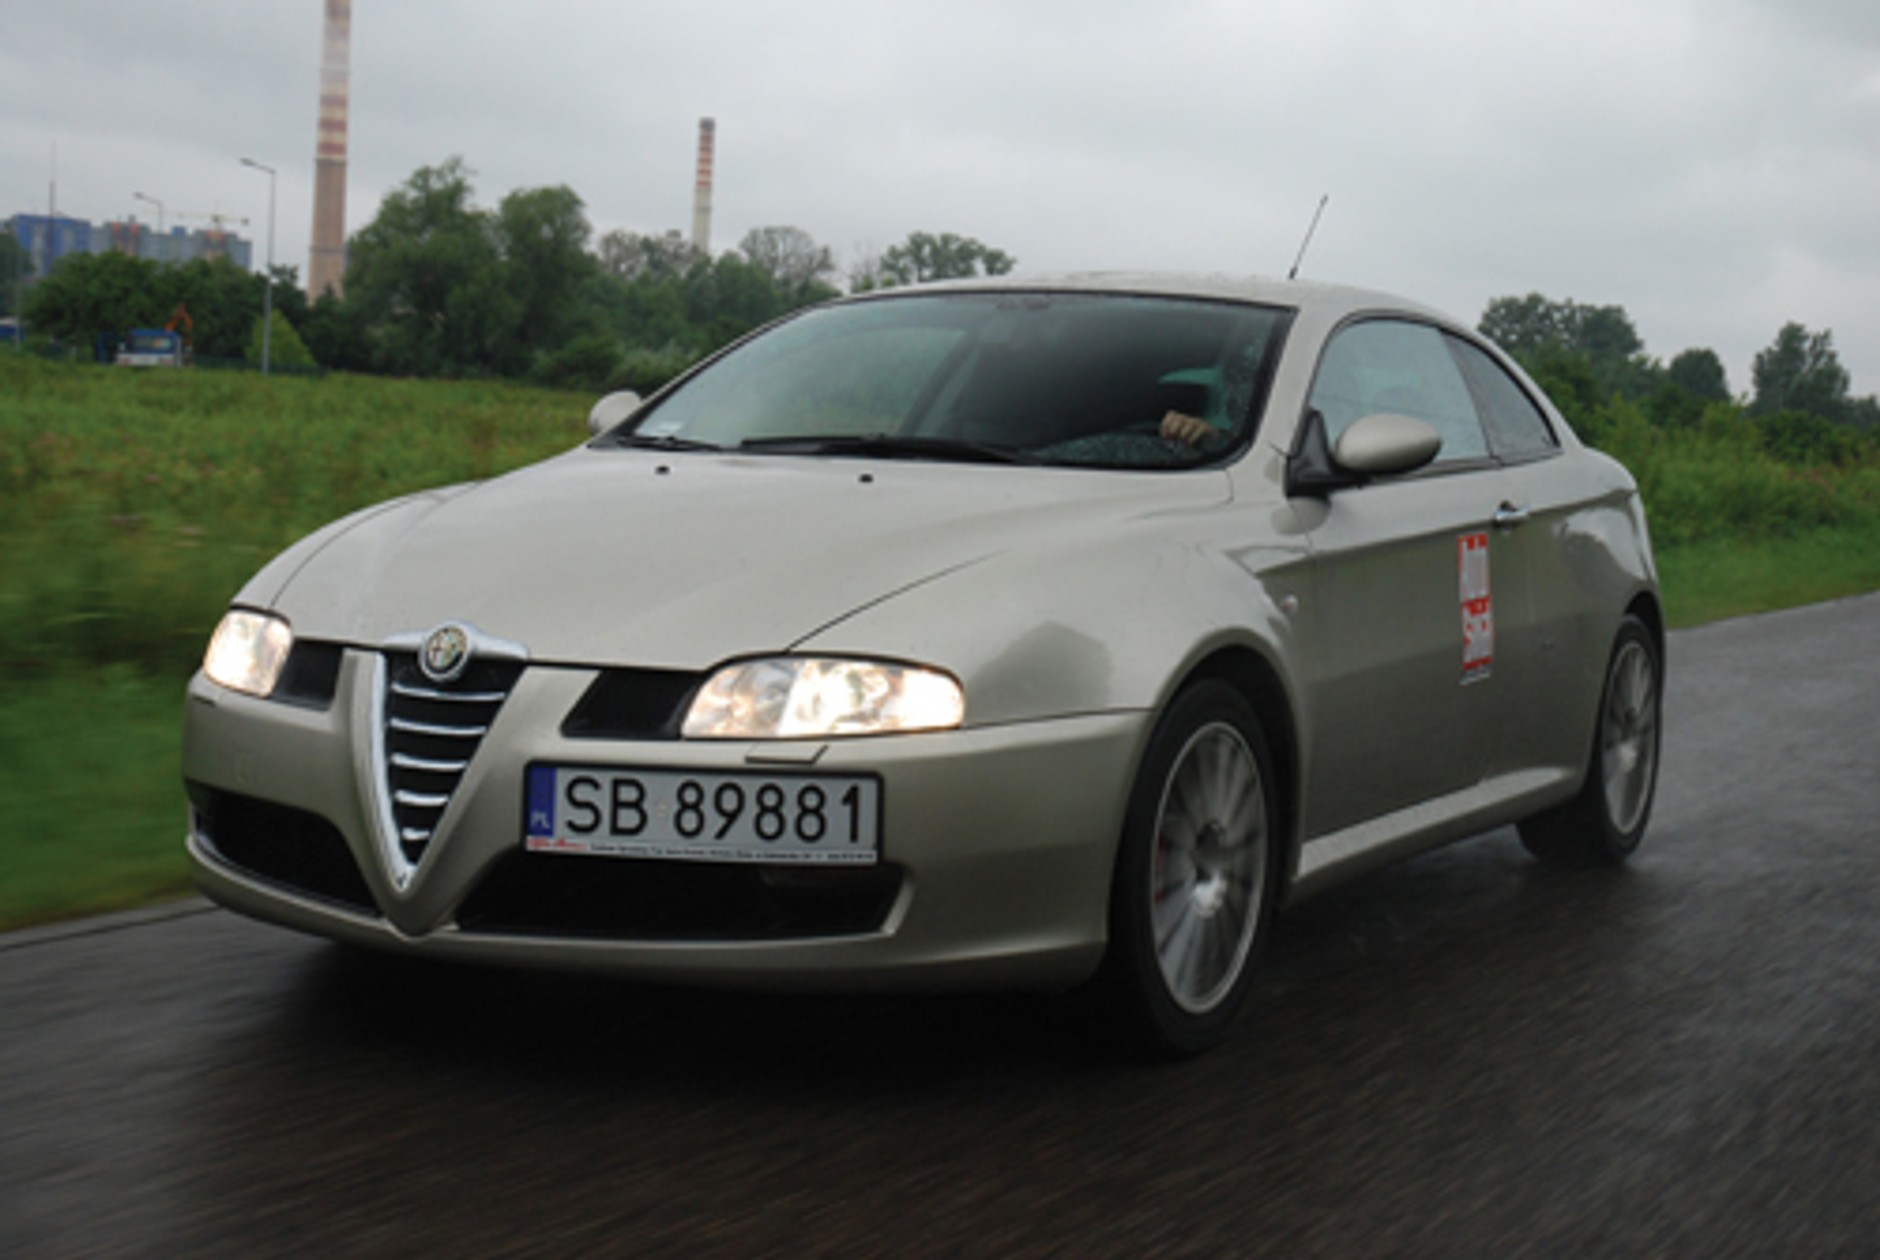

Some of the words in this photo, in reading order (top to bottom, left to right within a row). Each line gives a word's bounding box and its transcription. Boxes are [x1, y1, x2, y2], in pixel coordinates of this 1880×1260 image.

[530, 811, 550, 829] PL
[565, 775, 649, 837] SB
[673, 779, 861, 844] 89881
